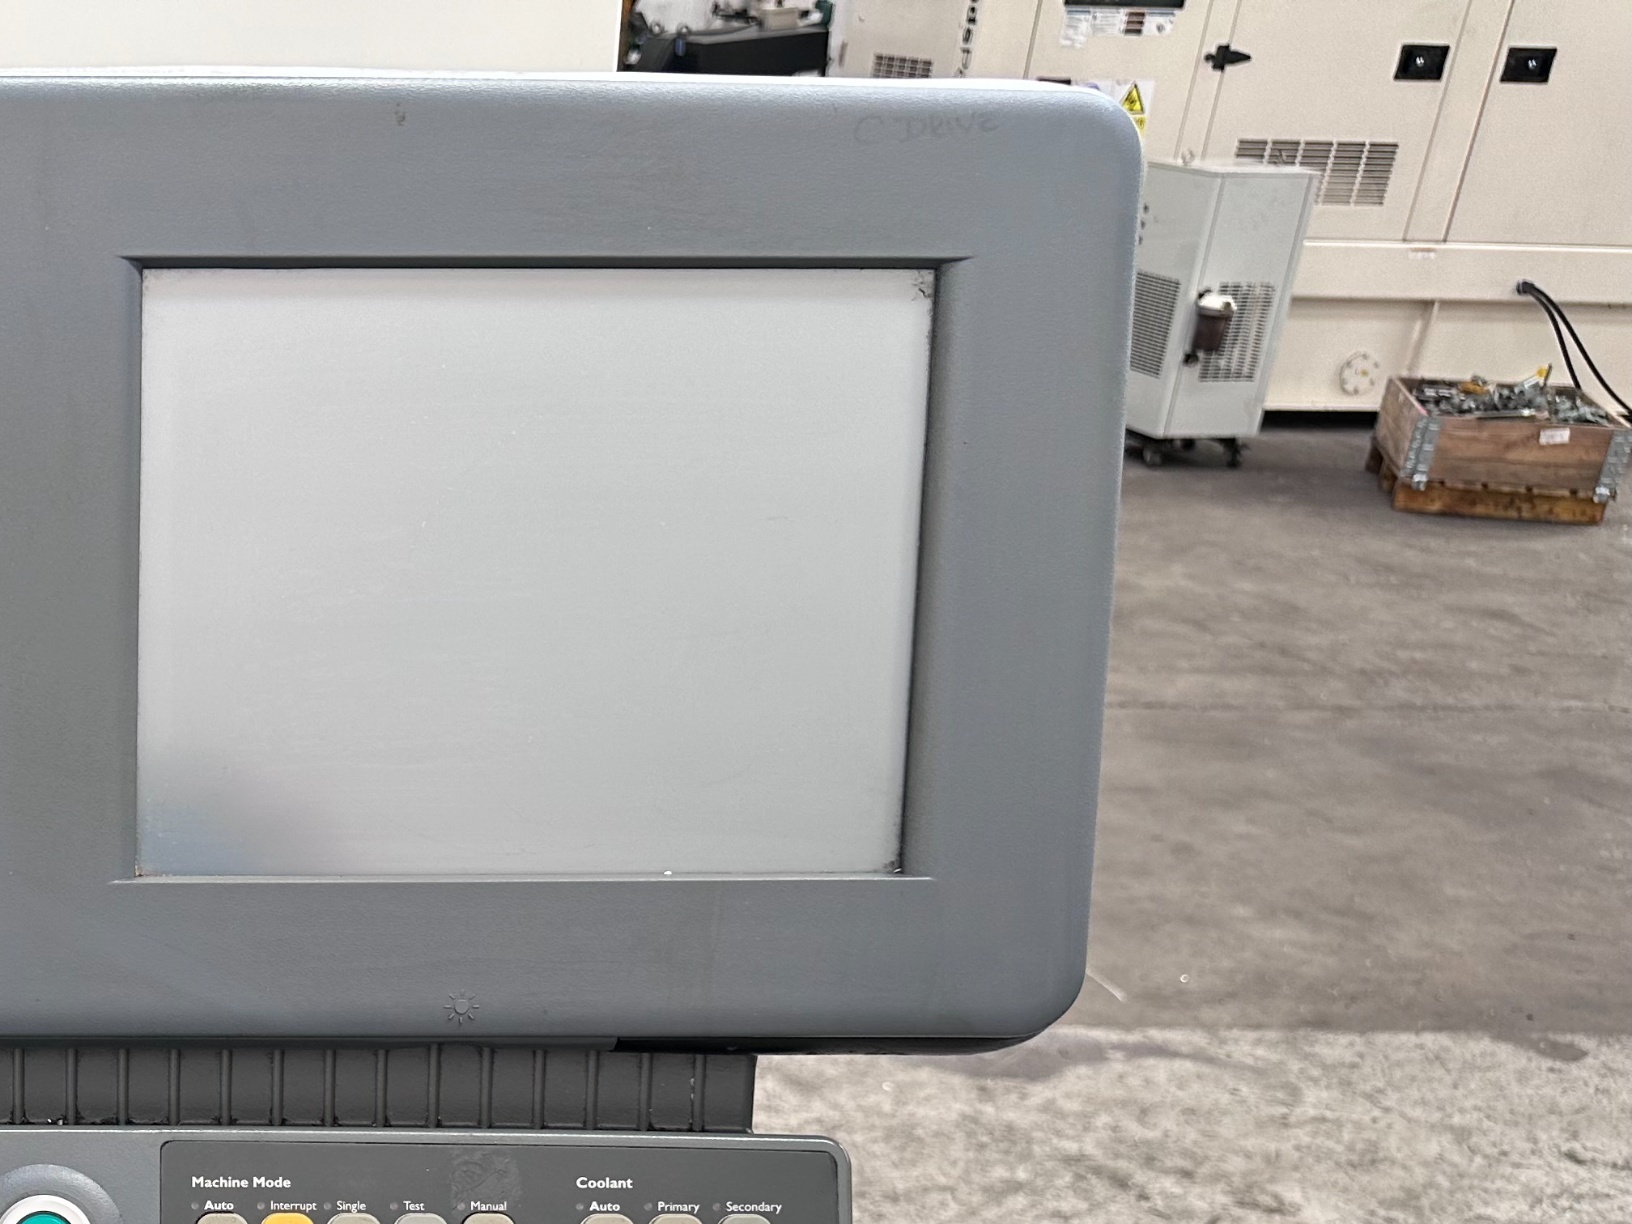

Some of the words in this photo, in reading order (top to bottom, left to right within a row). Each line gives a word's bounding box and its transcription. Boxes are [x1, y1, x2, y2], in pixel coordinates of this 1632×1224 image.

[191, 1175, 248, 1187] Machine
[252, 1176, 291, 1187] Mode
[575, 1176, 633, 1188] Coolant
[203, 1199, 234, 1210] Auto
[270, 1200, 316, 1214] Interrupt
[336, 1200, 366, 1214] Single
[402, 1200, 424, 1210] Test
[470, 1200, 507, 1210] Manual
[589, 1200, 620, 1211] Auto
[657, 1201, 699, 1215] Primary
[725, 1201, 782, 1215] Secondary
